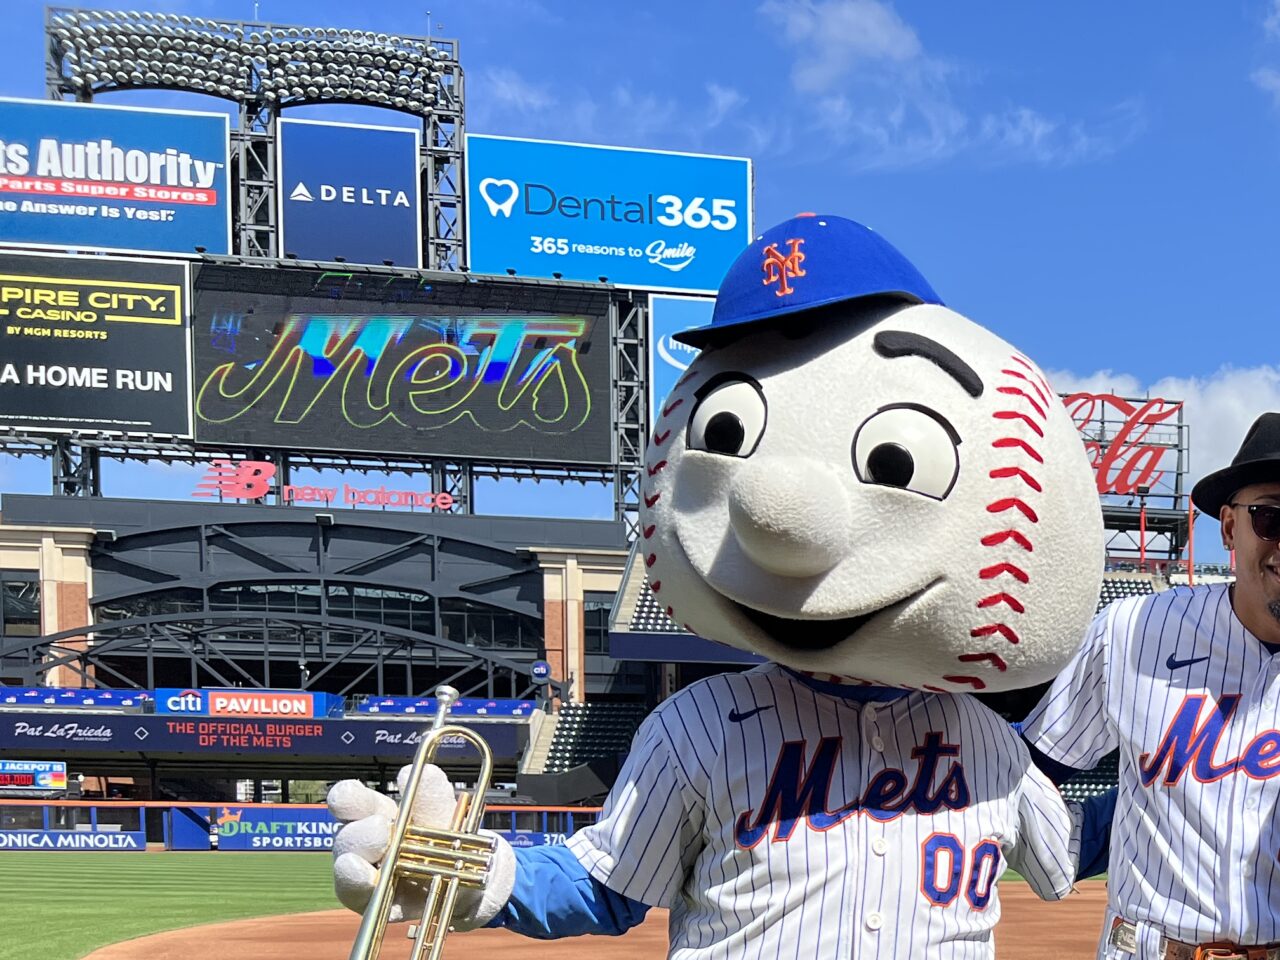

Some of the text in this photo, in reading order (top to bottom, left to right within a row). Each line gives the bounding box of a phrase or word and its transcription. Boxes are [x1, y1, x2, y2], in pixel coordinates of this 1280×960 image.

[0, 177, 208, 202] Parts Super Stores
[320, 184, 411, 208] DELTA
[20, 200, 97, 216] Answer
[101, 205, 120, 217] Is
[530, 235, 696, 267] 365 reasons to Smile
[16, 307, 98, 323] CASINO
[7, 326, 108, 340] BY MGM RESORTS
[0, 363, 173, 392] A HOME RUN
[195, 313, 592, 436] Mets
[283, 484, 454, 511] new balance
[167, 692, 201, 711] citi
[215, 698, 307, 714] PAVILION
[14, 722, 113, 739] Pat LaFrieda
[167, 722, 323, 736] THE OFFICIAL BURGER
[375, 730, 401, 744] Pat
[199, 735, 291, 748] OF THE METS
[5, 762, 51, 771] JACKPOT
[52, 764, 63, 772] IS
[734, 730, 971, 851] Mets
[57, 834, 137, 848] MINOLTA
[543, 833, 566, 847] 370
[920, 831, 1001, 912] 00
